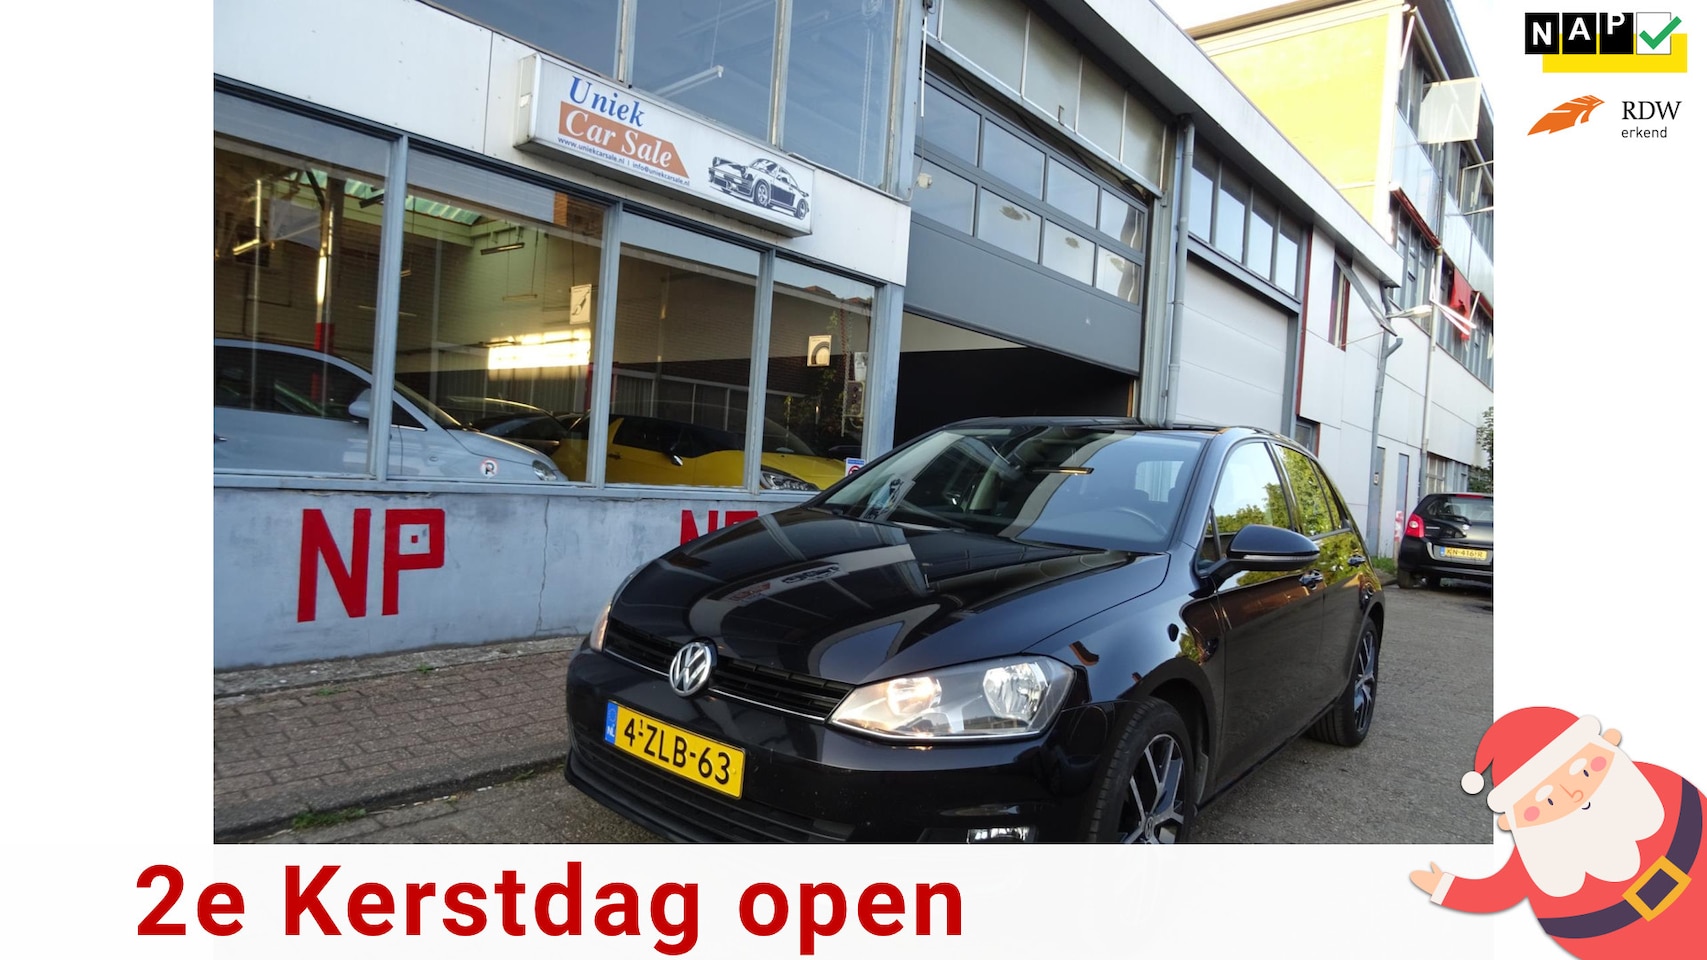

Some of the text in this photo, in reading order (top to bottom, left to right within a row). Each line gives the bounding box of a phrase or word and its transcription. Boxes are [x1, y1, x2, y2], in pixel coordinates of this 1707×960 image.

[569, 75, 646, 127] Uniek
[557, 137, 625, 164] www.uniekcarsale.nl
[632, 161, 690, 186] info@uniekcarsale.nl
[565, 109, 673, 168] Car Sale
[297, 508, 445, 622] NP
[606, 724, 616, 738] NL
